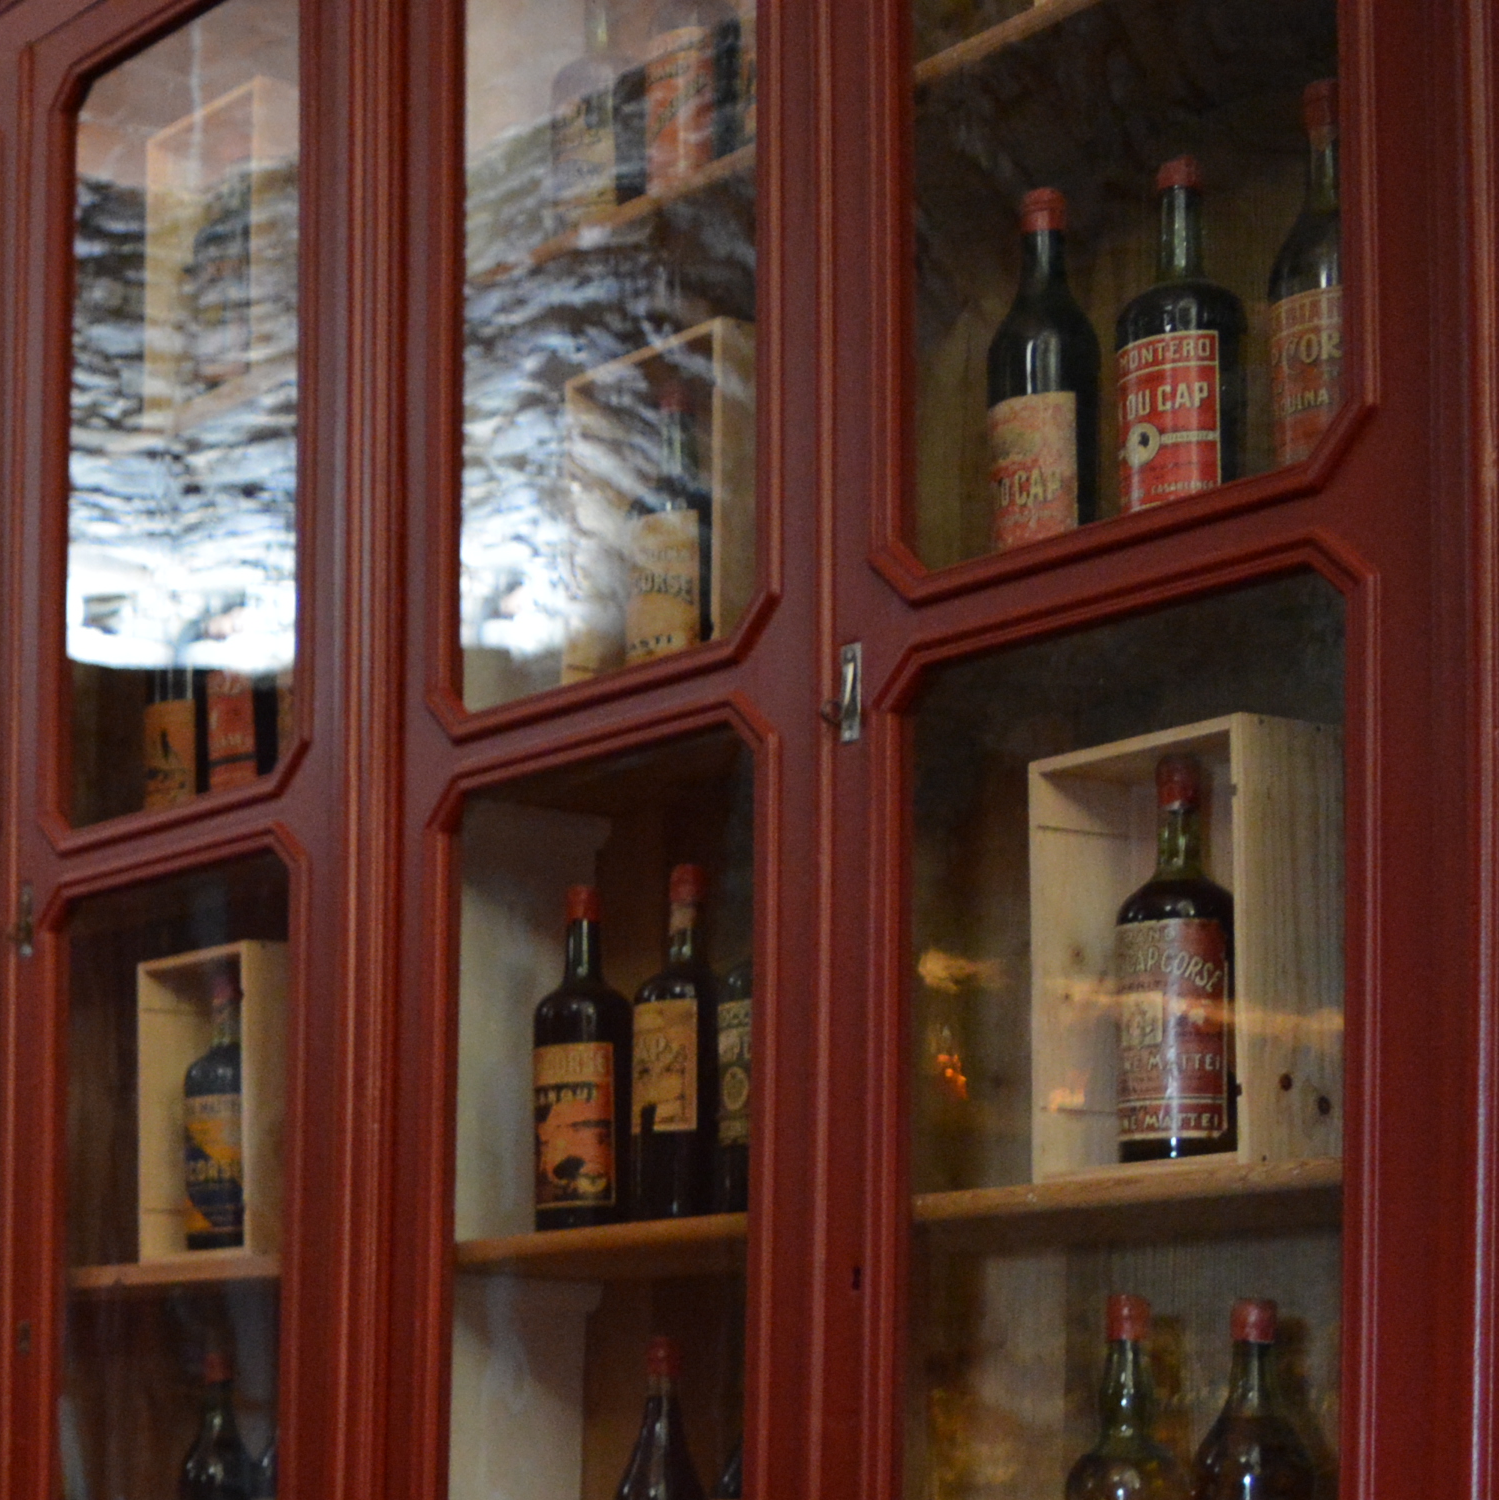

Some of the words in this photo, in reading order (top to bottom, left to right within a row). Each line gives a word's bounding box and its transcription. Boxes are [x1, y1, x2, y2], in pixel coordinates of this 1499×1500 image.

[1156, 381, 1208, 412] CAP
[1014, 467, 1062, 506] CAP
[1161, 948, 1224, 993] CORSE
[1143, 1112, 1219, 1129] MATTEI
